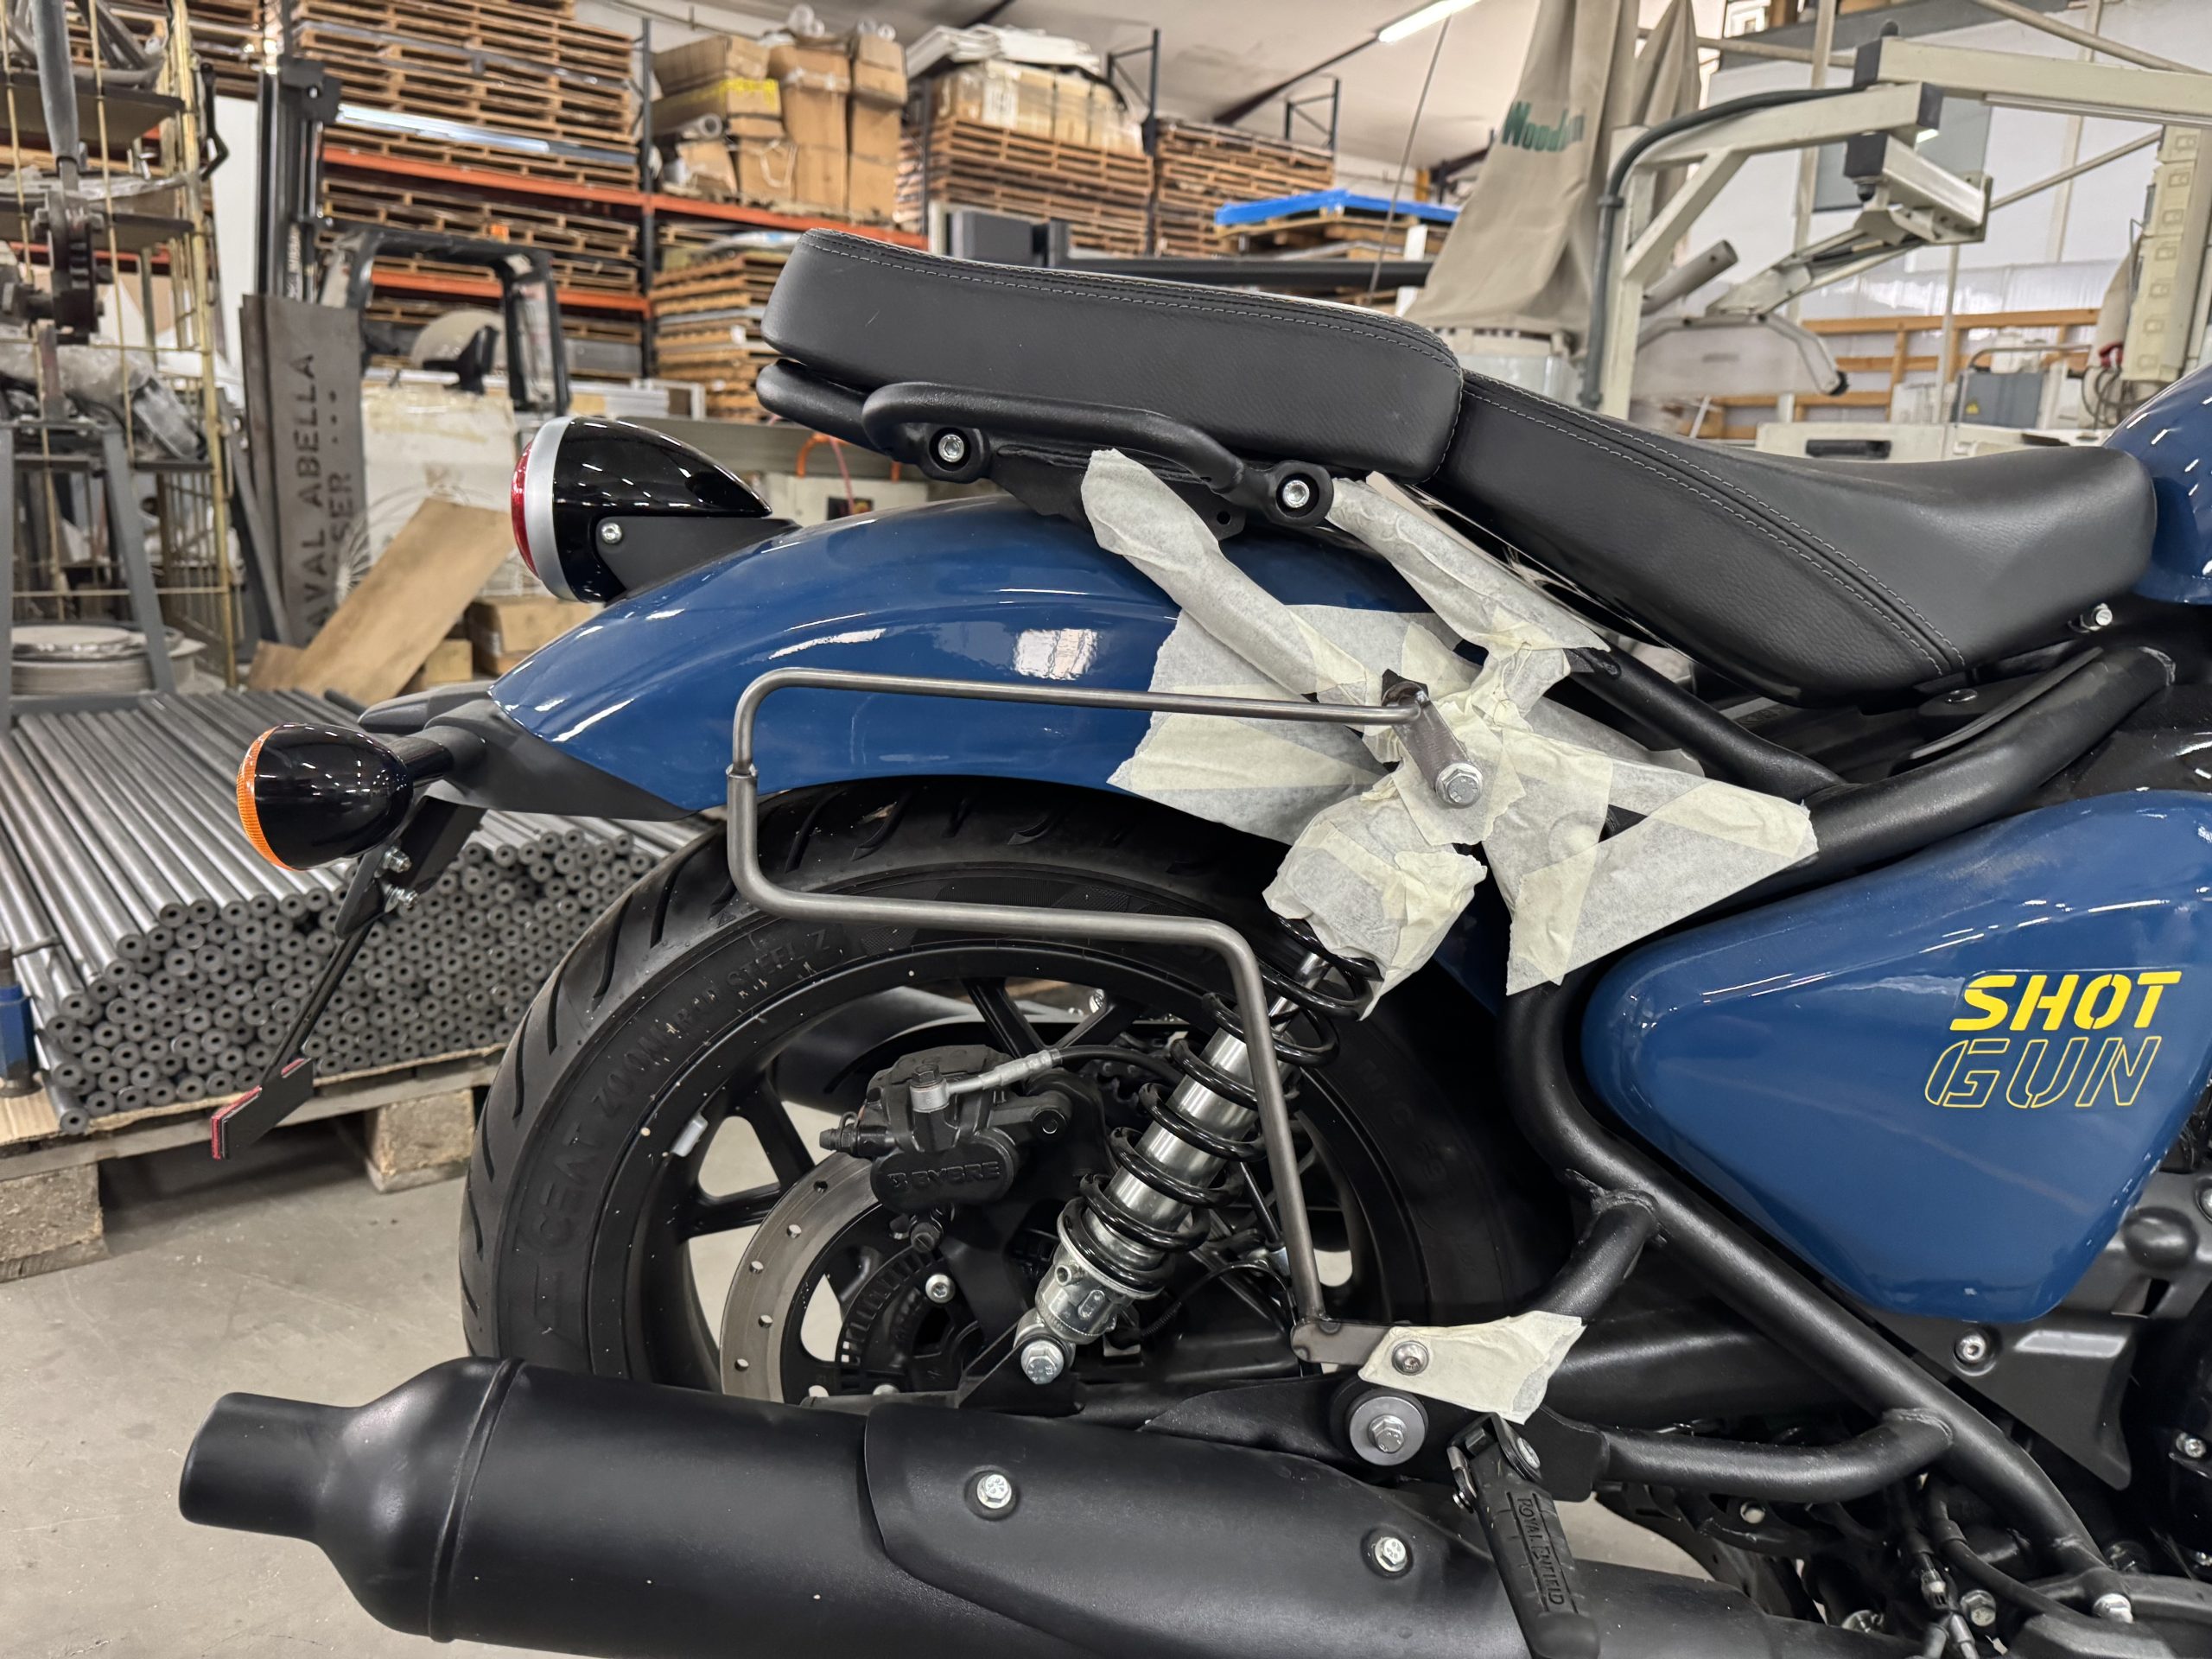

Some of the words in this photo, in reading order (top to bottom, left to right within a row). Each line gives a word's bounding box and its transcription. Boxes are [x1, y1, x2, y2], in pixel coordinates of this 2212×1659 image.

[289, 353, 322, 508] ABELLA
[1948, 969, 2183, 1032] SHOT
[1923, 1035, 2162, 1109] GUN
[911, 1160, 1001, 1189] BYBRE
